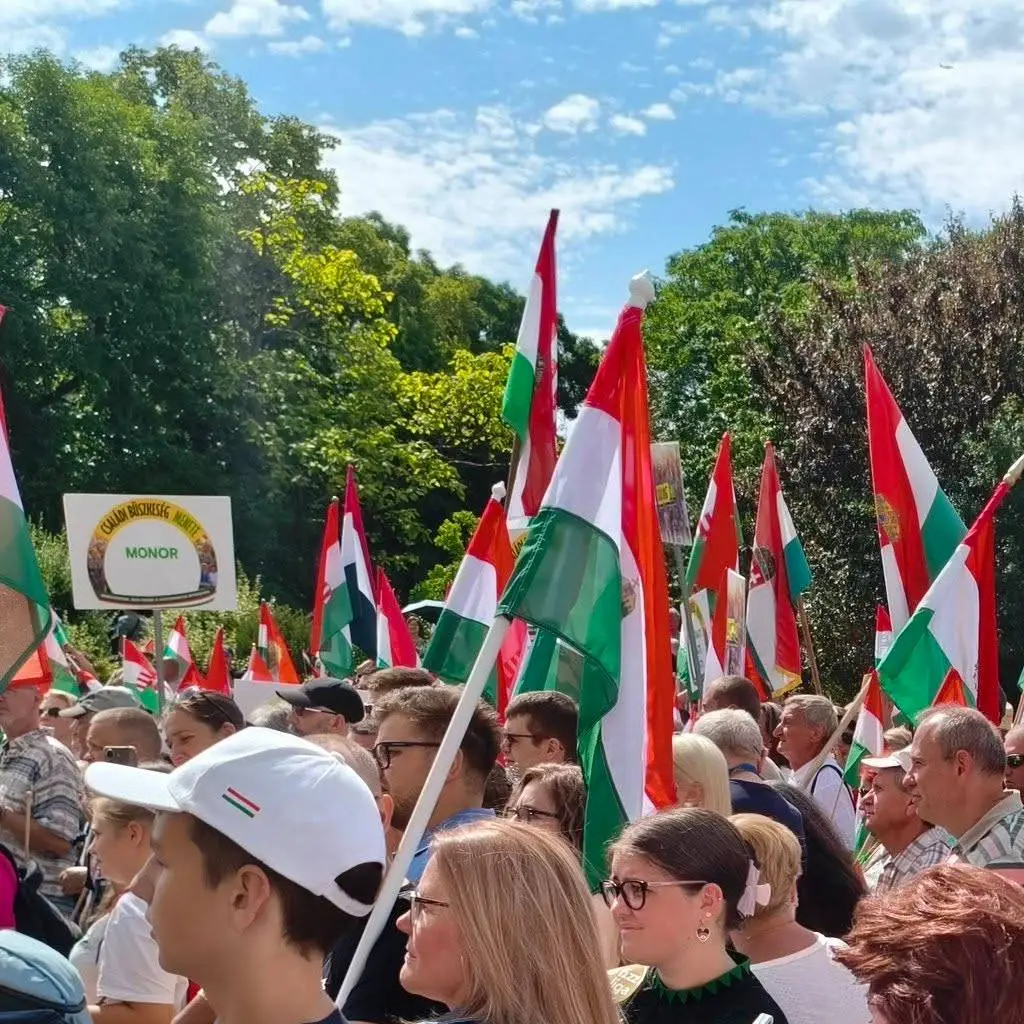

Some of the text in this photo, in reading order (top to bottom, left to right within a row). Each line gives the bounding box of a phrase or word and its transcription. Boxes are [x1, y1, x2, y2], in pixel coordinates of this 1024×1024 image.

[100, 507, 129, 535] CSALÁDI
[127, 501, 171, 519] BÜSZKESÉG
[125, 546, 179, 559] MONOR
